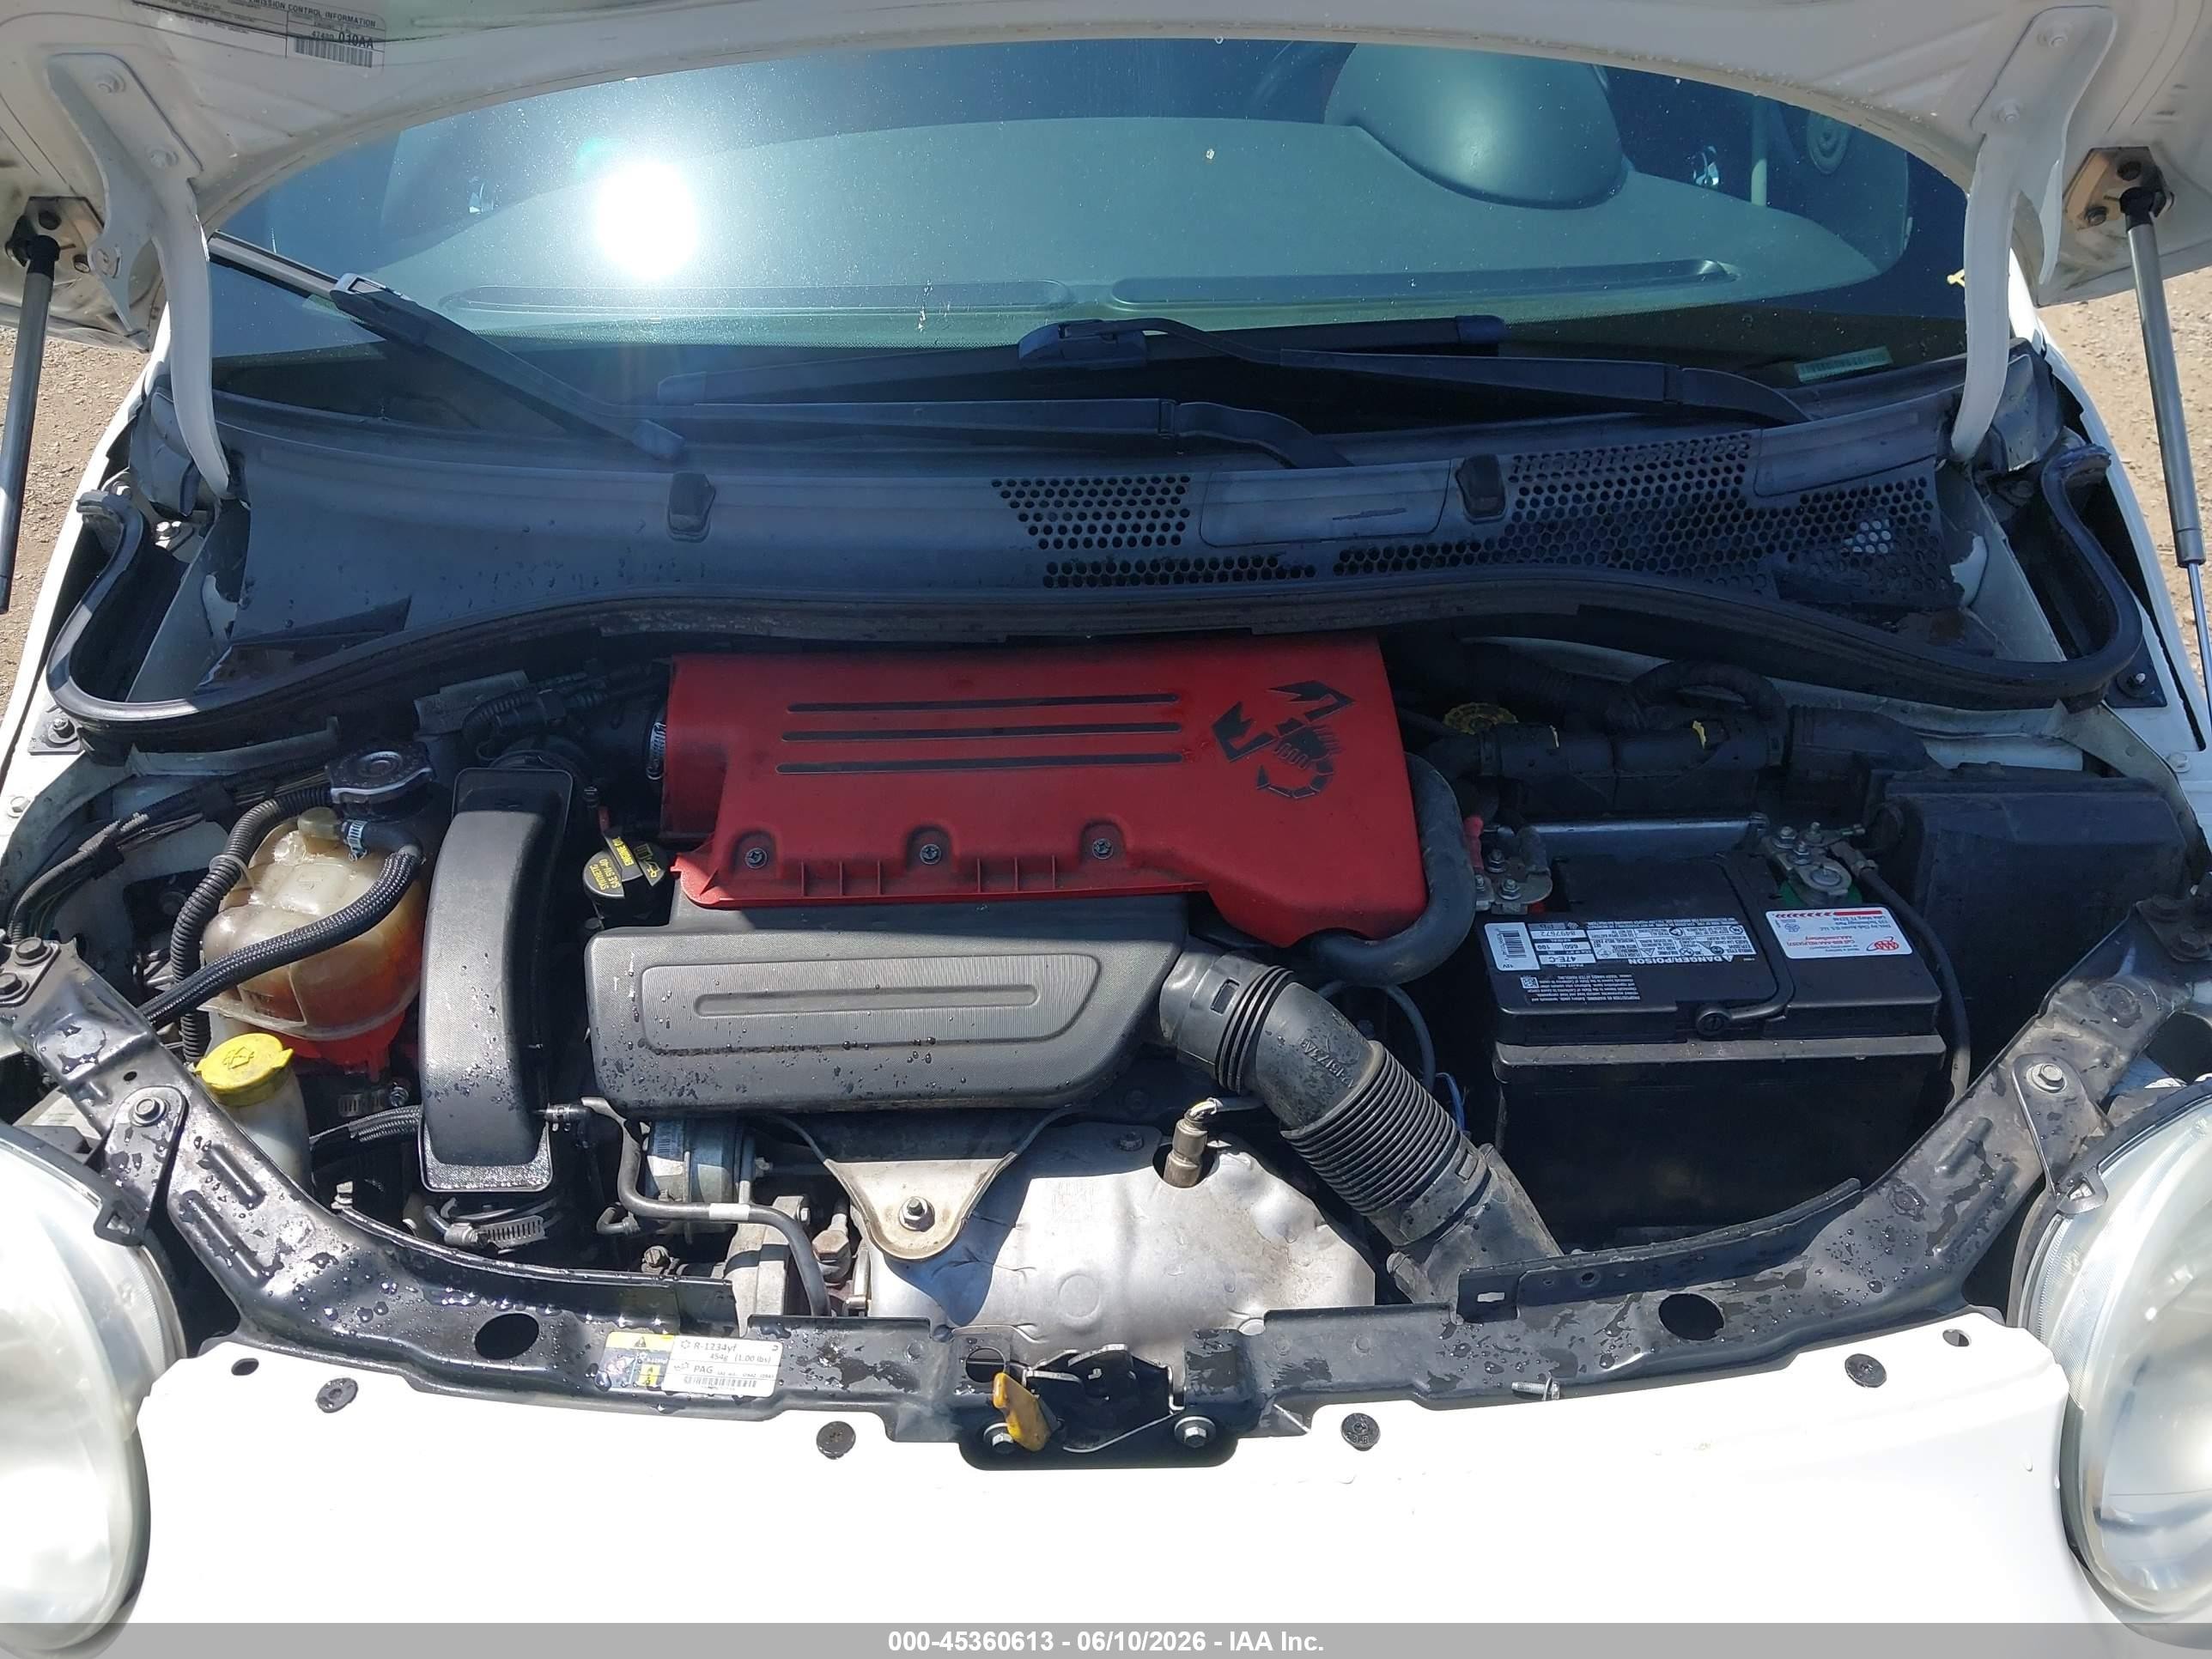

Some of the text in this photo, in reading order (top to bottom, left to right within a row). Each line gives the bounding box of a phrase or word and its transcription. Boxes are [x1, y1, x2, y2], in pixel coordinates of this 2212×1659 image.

[288, 3, 322, 16] CONTROL
[325, 10, 376, 27] INFORMATION
[611, 837, 635, 866] ENGINE OIL
[589, 864, 609, 890] SYNTHETIC
[599, 859, 621, 889] SAE 5W-40
[1627, 956, 1723, 964] DANGER/POISON
[693, 1341, 737, 1353] R-1234yf
[710, 1352, 729, 1362] 454g
[757, 1355, 771, 1364] lbs)
[693, 1364, 714, 1374] PAG
